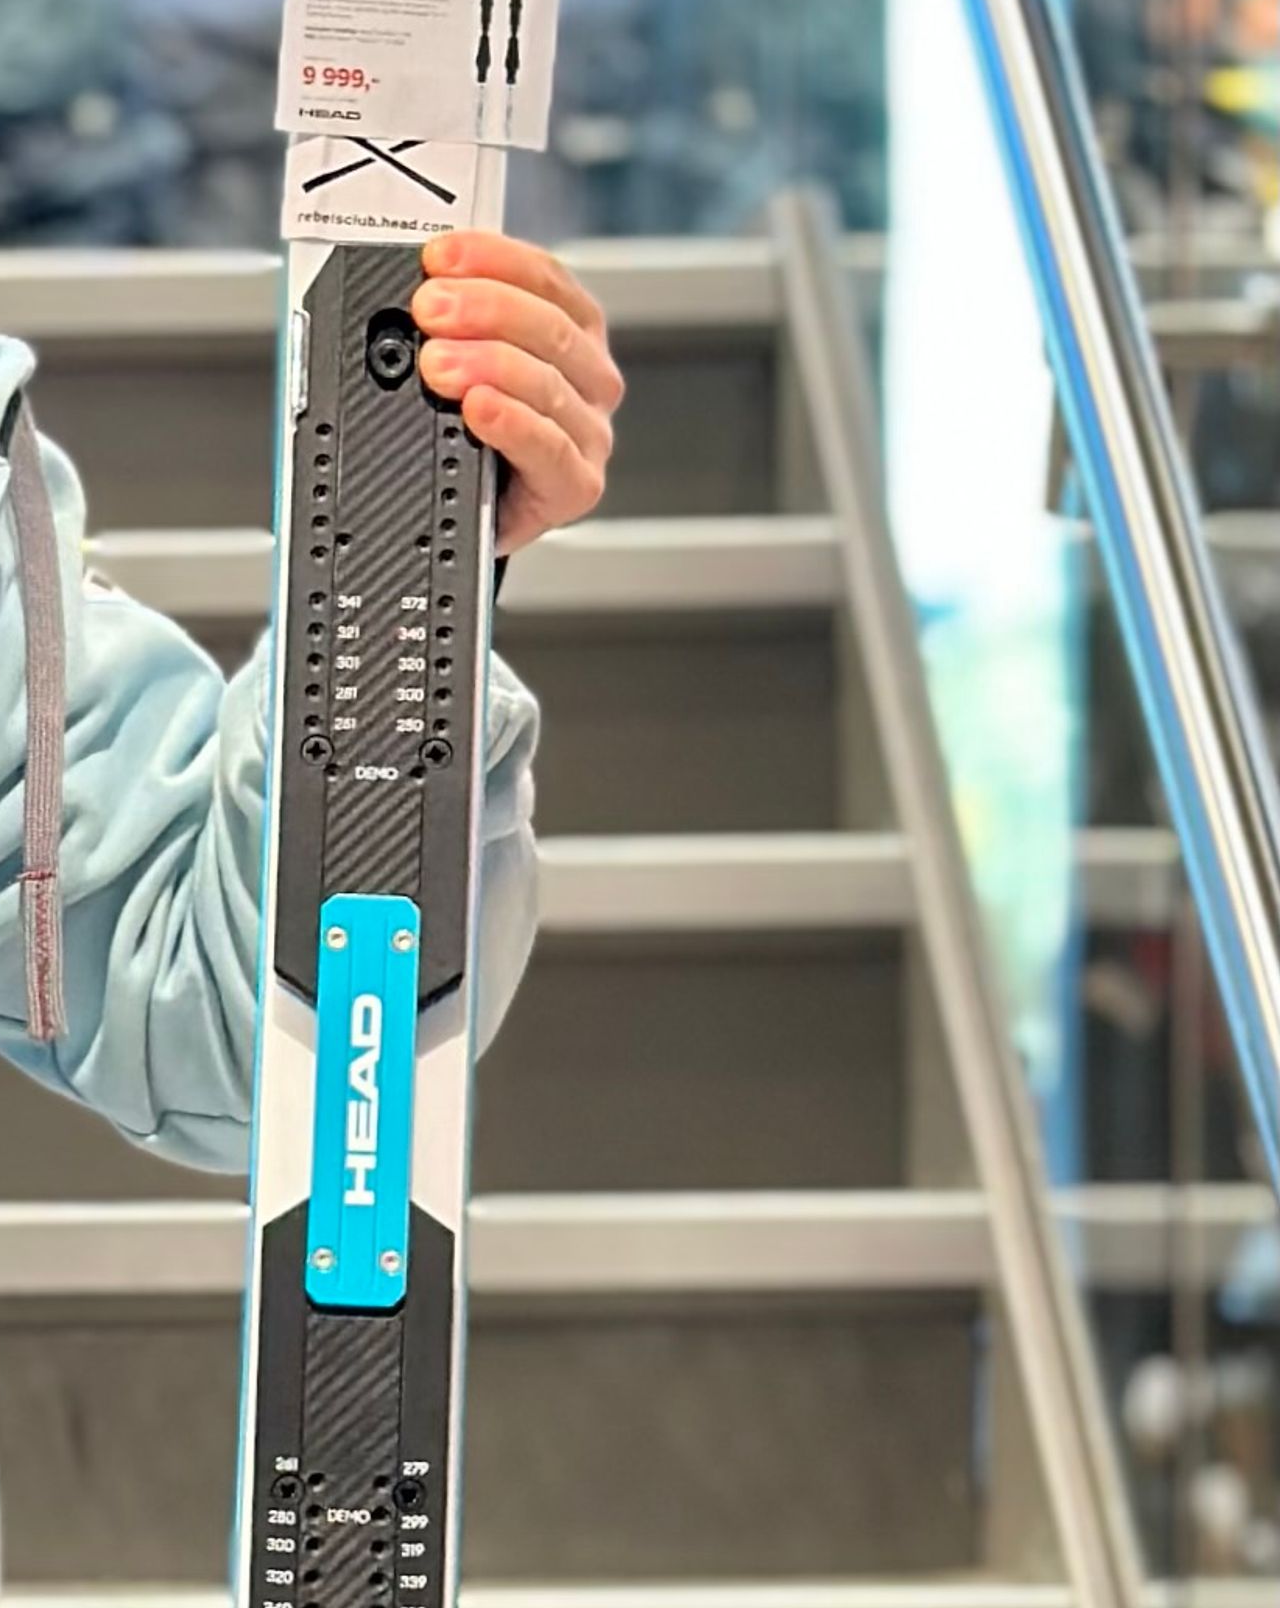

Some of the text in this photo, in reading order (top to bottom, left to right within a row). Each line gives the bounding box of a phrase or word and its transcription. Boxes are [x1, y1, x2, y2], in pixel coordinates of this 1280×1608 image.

[303, 66, 381, 93] 9 999,-
[298, 108, 362, 121] HEAD
[297, 211, 455, 233] rebelsclub.head.com
[354, 766, 399, 781] DEMO
[343, 993, 383, 1206] HEAD
[401, 1460, 430, 1476] 279
[326, 1507, 371, 1525] DEMO
[400, 1515, 429, 1530] 299
[266, 1537, 296, 1553] 300
[400, 1543, 426, 1558] 319
[265, 1569, 294, 1585] 320
[398, 1574, 428, 1589] 339
